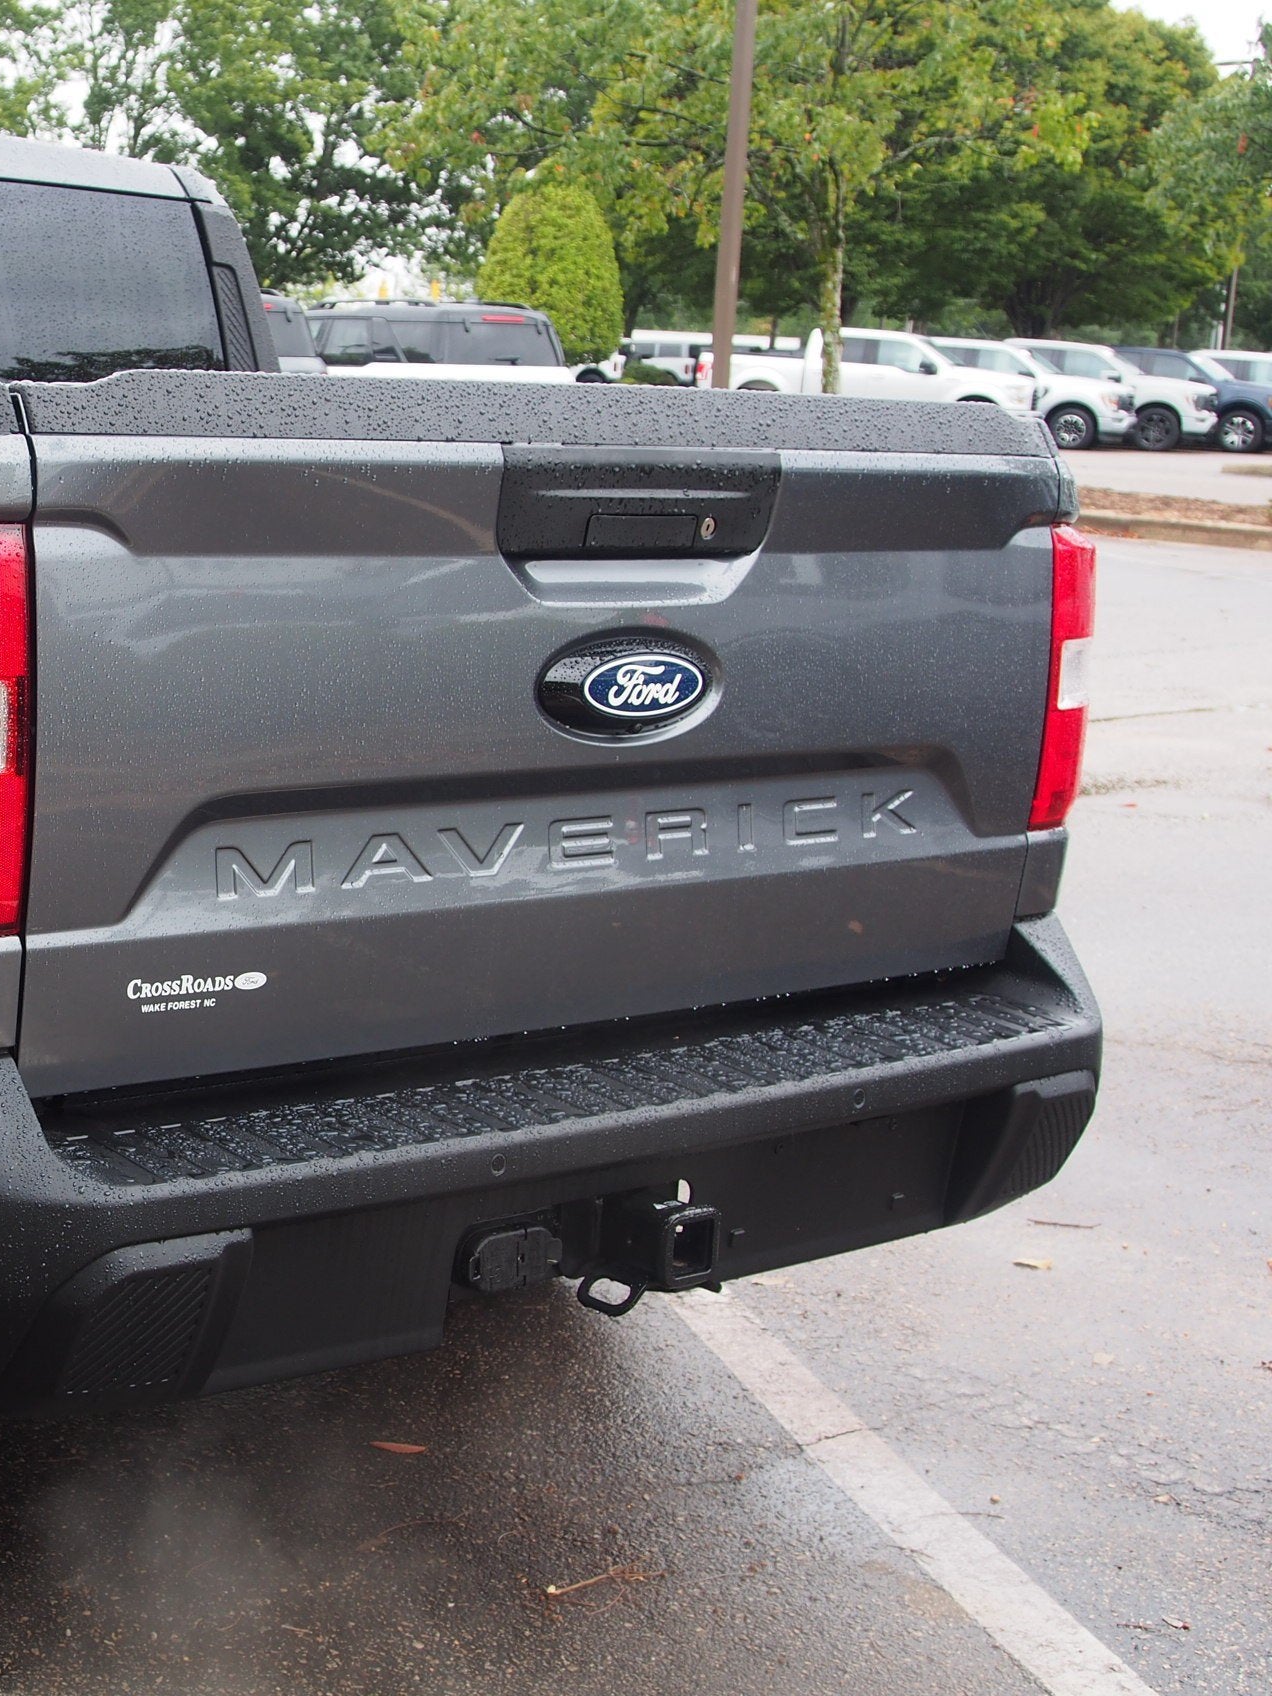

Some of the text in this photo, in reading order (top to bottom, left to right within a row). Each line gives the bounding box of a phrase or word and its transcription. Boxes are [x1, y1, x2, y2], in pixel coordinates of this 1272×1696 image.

[607, 664, 683, 707] Ford
[214, 788, 918, 901] MAVERICK
[141, 998, 216, 1013] WAKE FOREST NC
